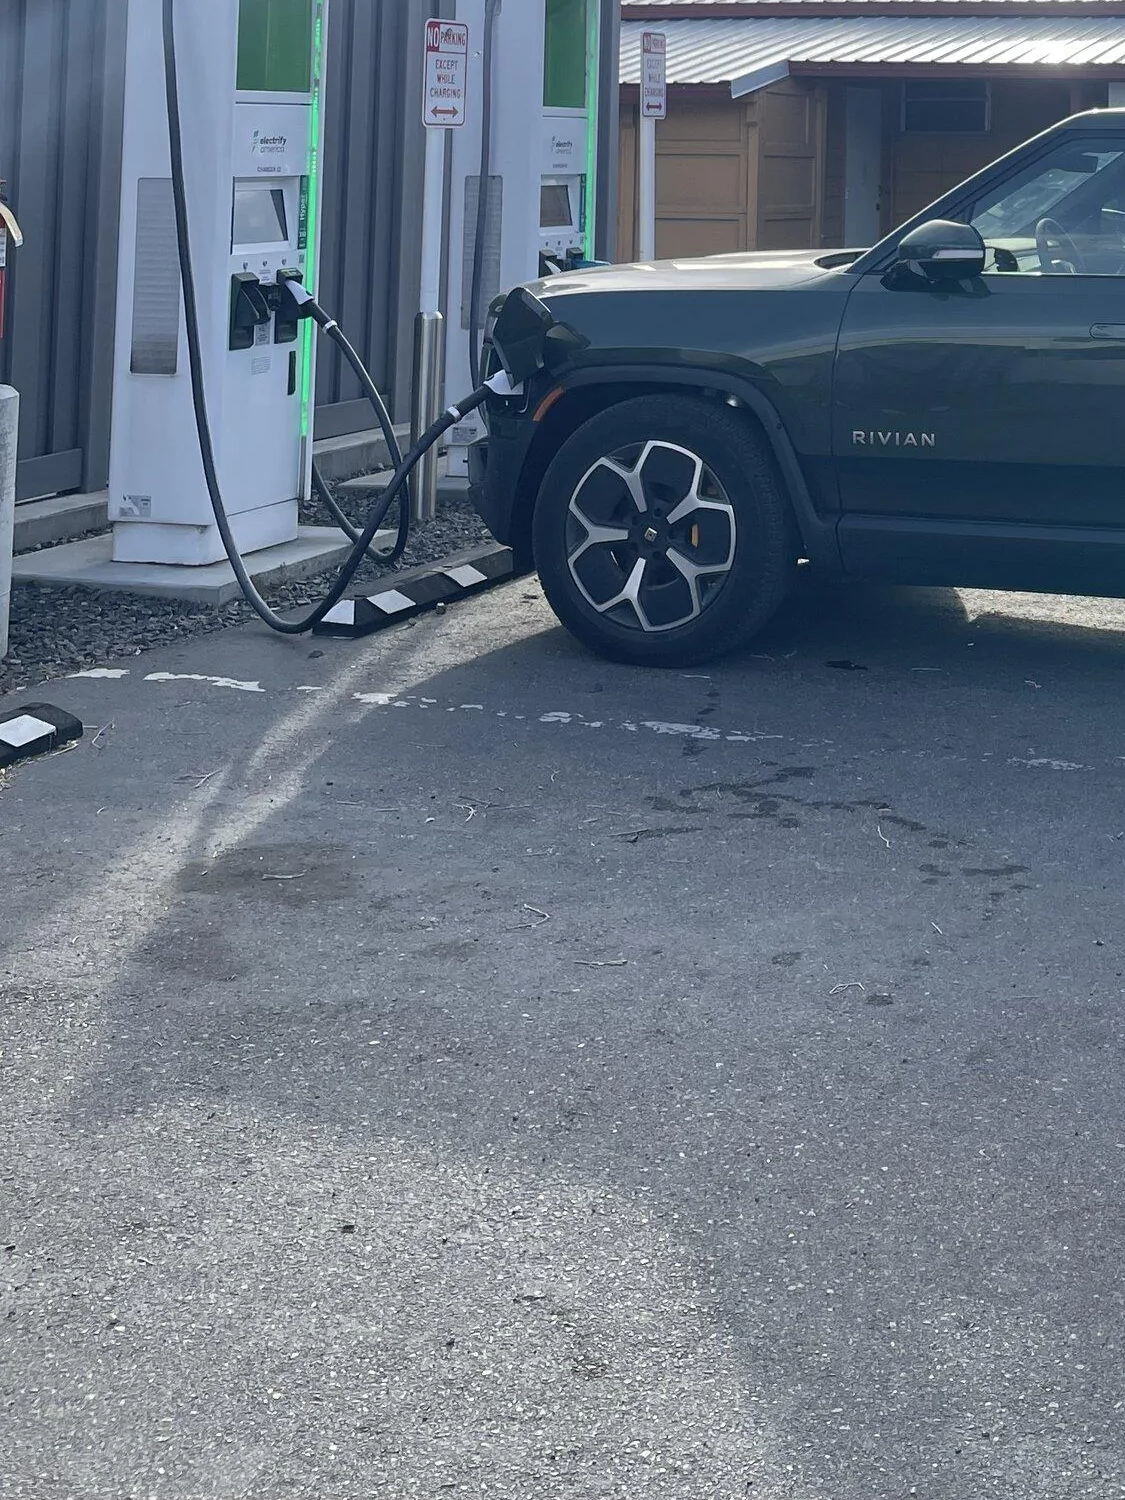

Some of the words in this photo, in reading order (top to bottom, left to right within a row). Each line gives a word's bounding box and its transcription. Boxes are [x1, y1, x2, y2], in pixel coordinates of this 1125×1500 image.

[427, 26, 439, 47] NO
[440, 31, 466, 46] PARKING
[435, 59, 458, 71] EXCEPT
[436, 73, 455, 84] WHILE
[429, 87, 461, 99] CHARGING
[260, 136, 287, 146] electrify
[852, 430, 936, 447] RIVIAN
